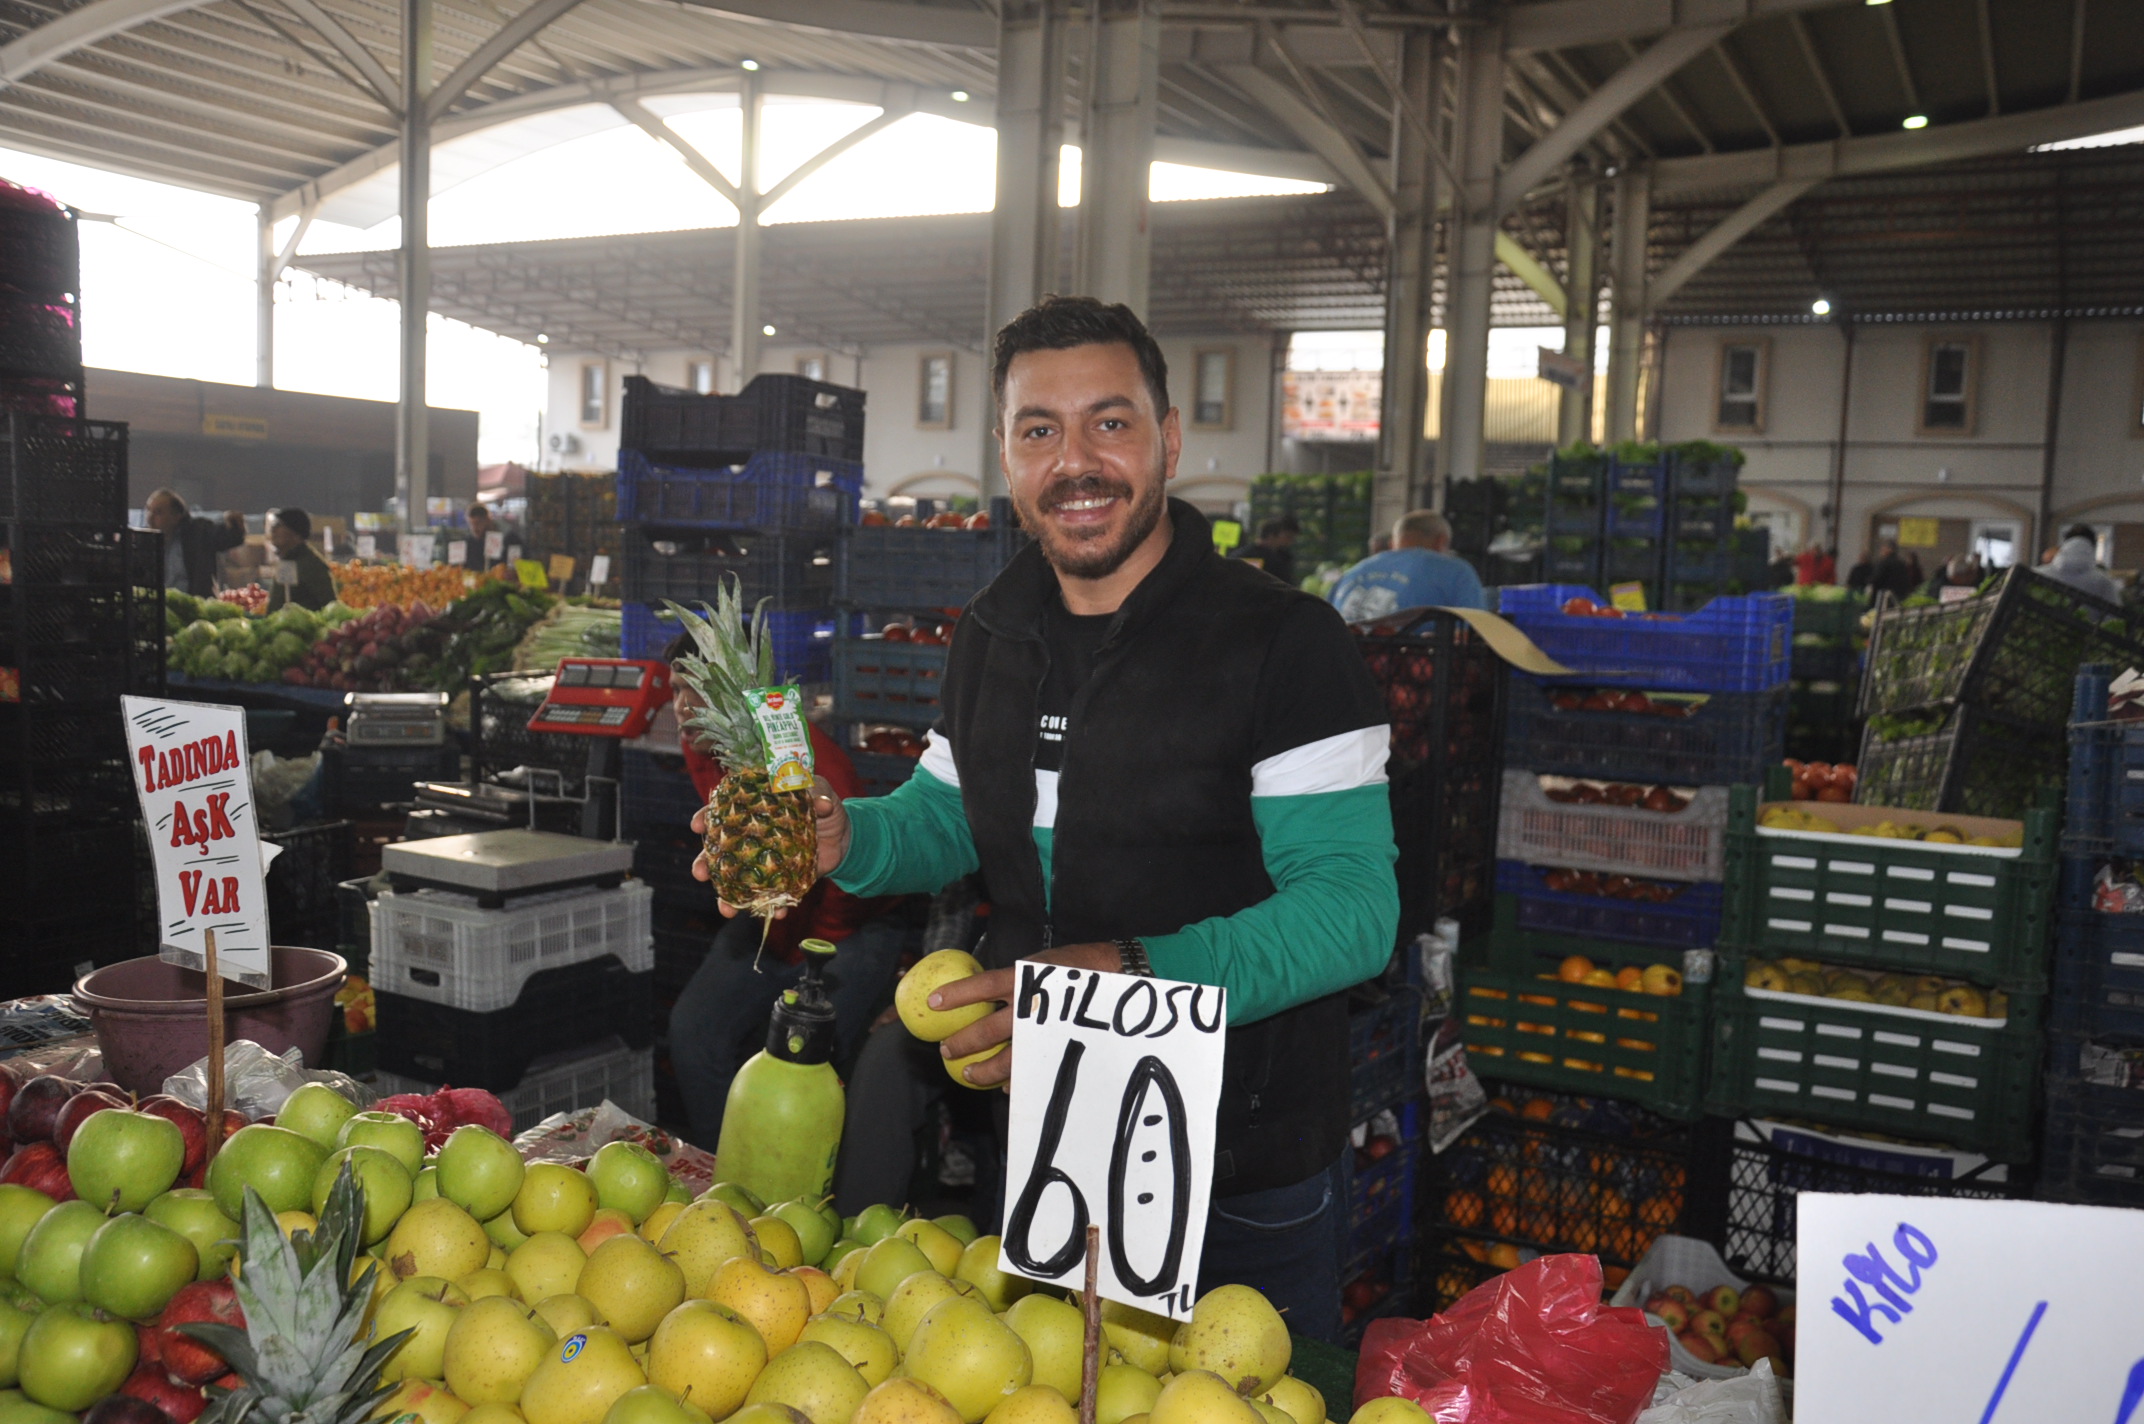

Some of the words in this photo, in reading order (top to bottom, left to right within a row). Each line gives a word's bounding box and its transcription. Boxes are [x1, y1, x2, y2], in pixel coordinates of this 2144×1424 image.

[767, 721, 798, 733] PINEAPPLE
[138, 729, 240, 793] TADINDA
[178, 869, 241, 917] VAR
[1158, 1284, 1193, 1319] TL
